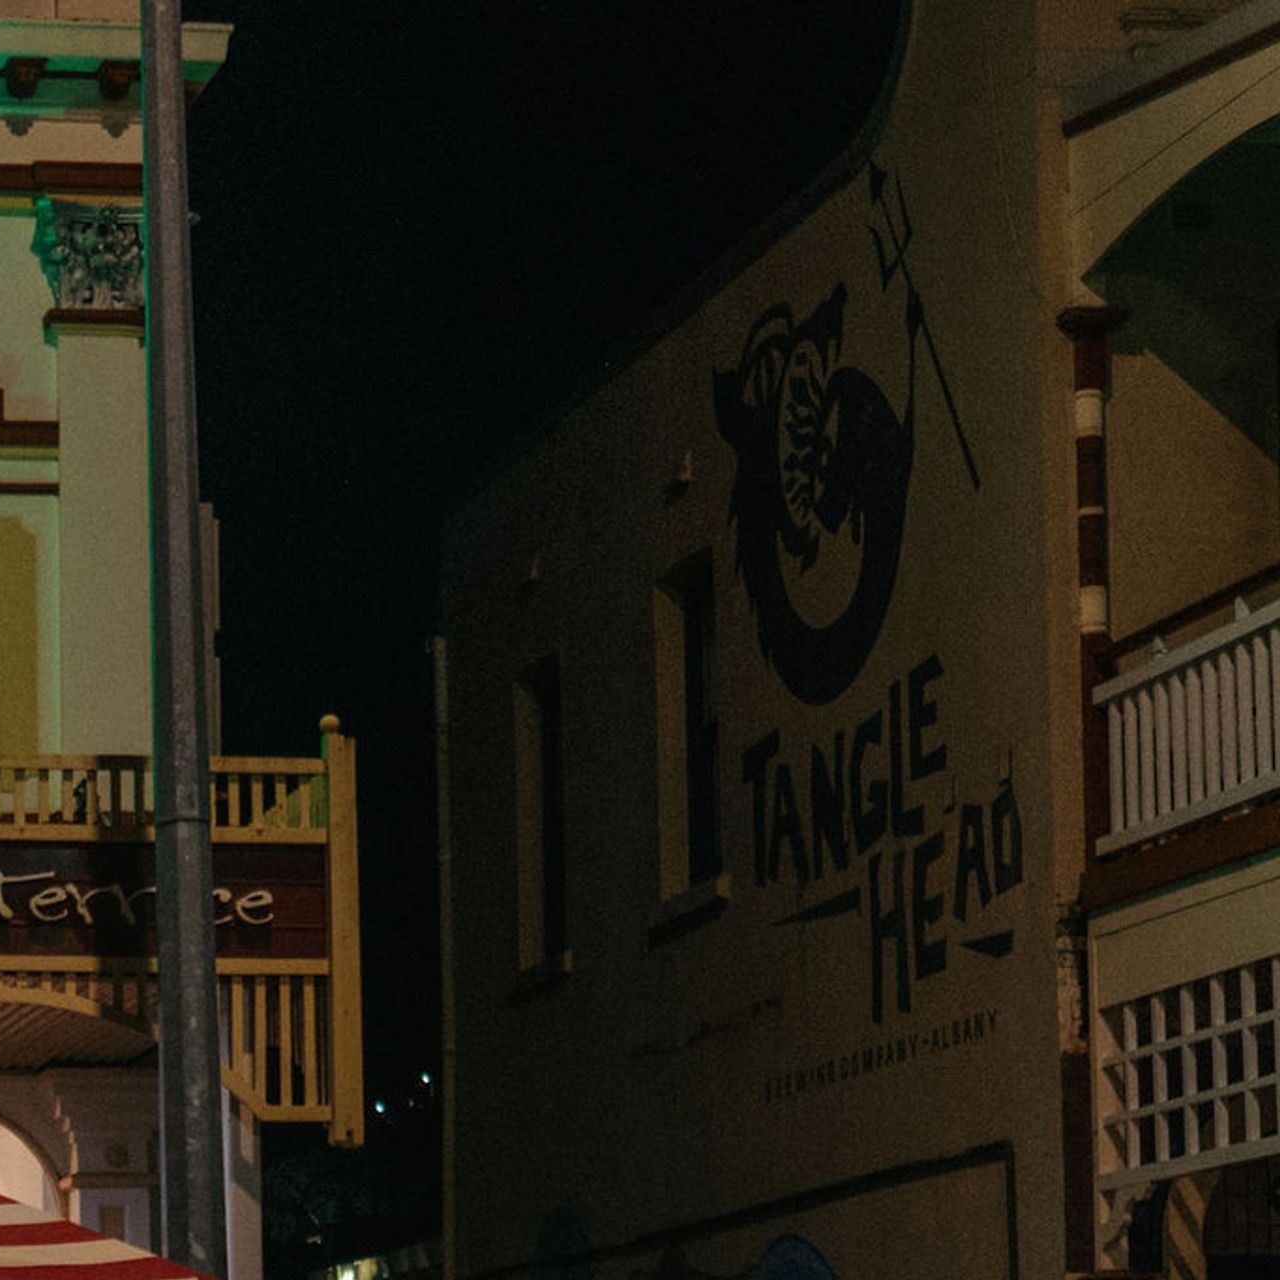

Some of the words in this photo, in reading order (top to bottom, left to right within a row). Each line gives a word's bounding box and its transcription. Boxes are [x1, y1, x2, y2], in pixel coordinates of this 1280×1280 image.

[742, 655, 948, 887] TANGLE
[867, 776, 1023, 1024] HEAD
[930, 1008, 997, 1052] ALBANY
